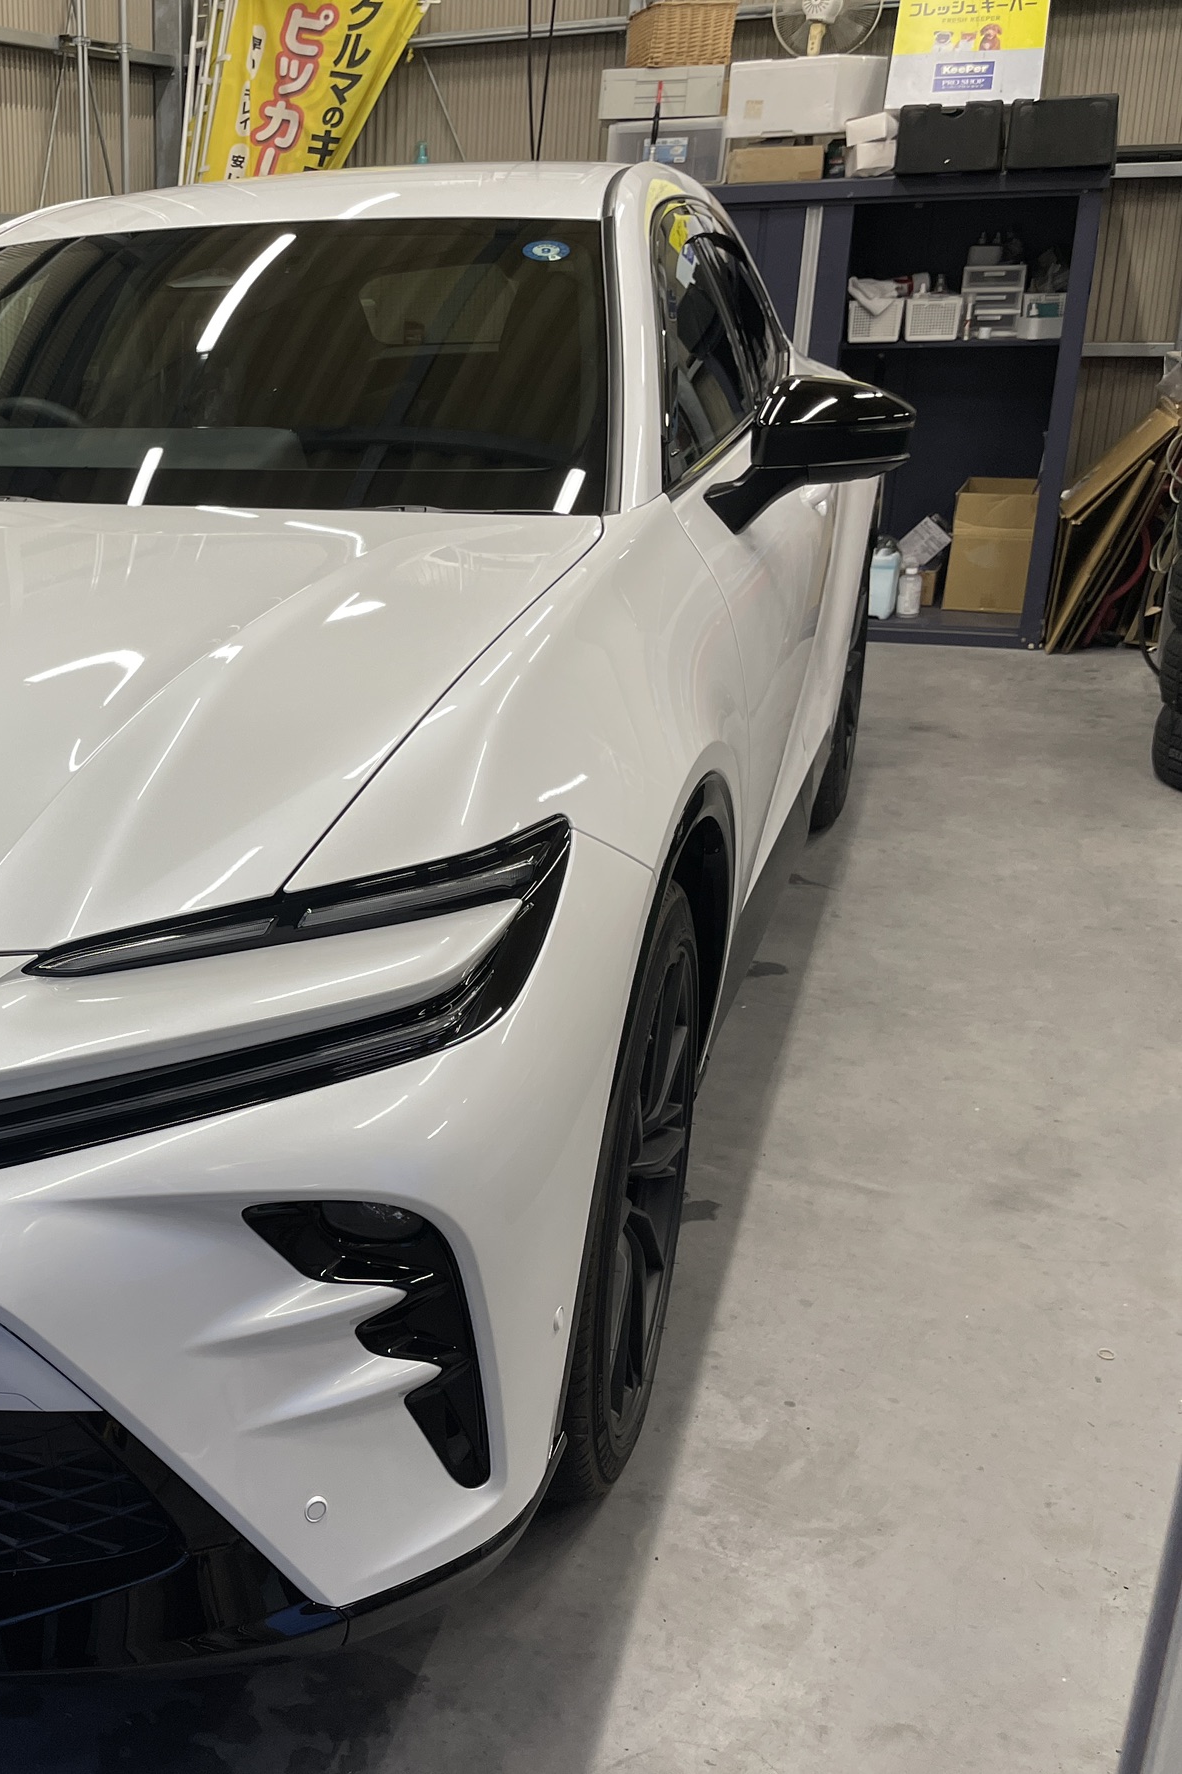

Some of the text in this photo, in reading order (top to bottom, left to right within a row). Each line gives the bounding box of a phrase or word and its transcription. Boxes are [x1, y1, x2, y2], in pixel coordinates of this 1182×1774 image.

[941, 64, 990, 75] KeePer
[304, 0, 383, 171] クルマのキ
[941, 79, 960, 87] PRO
